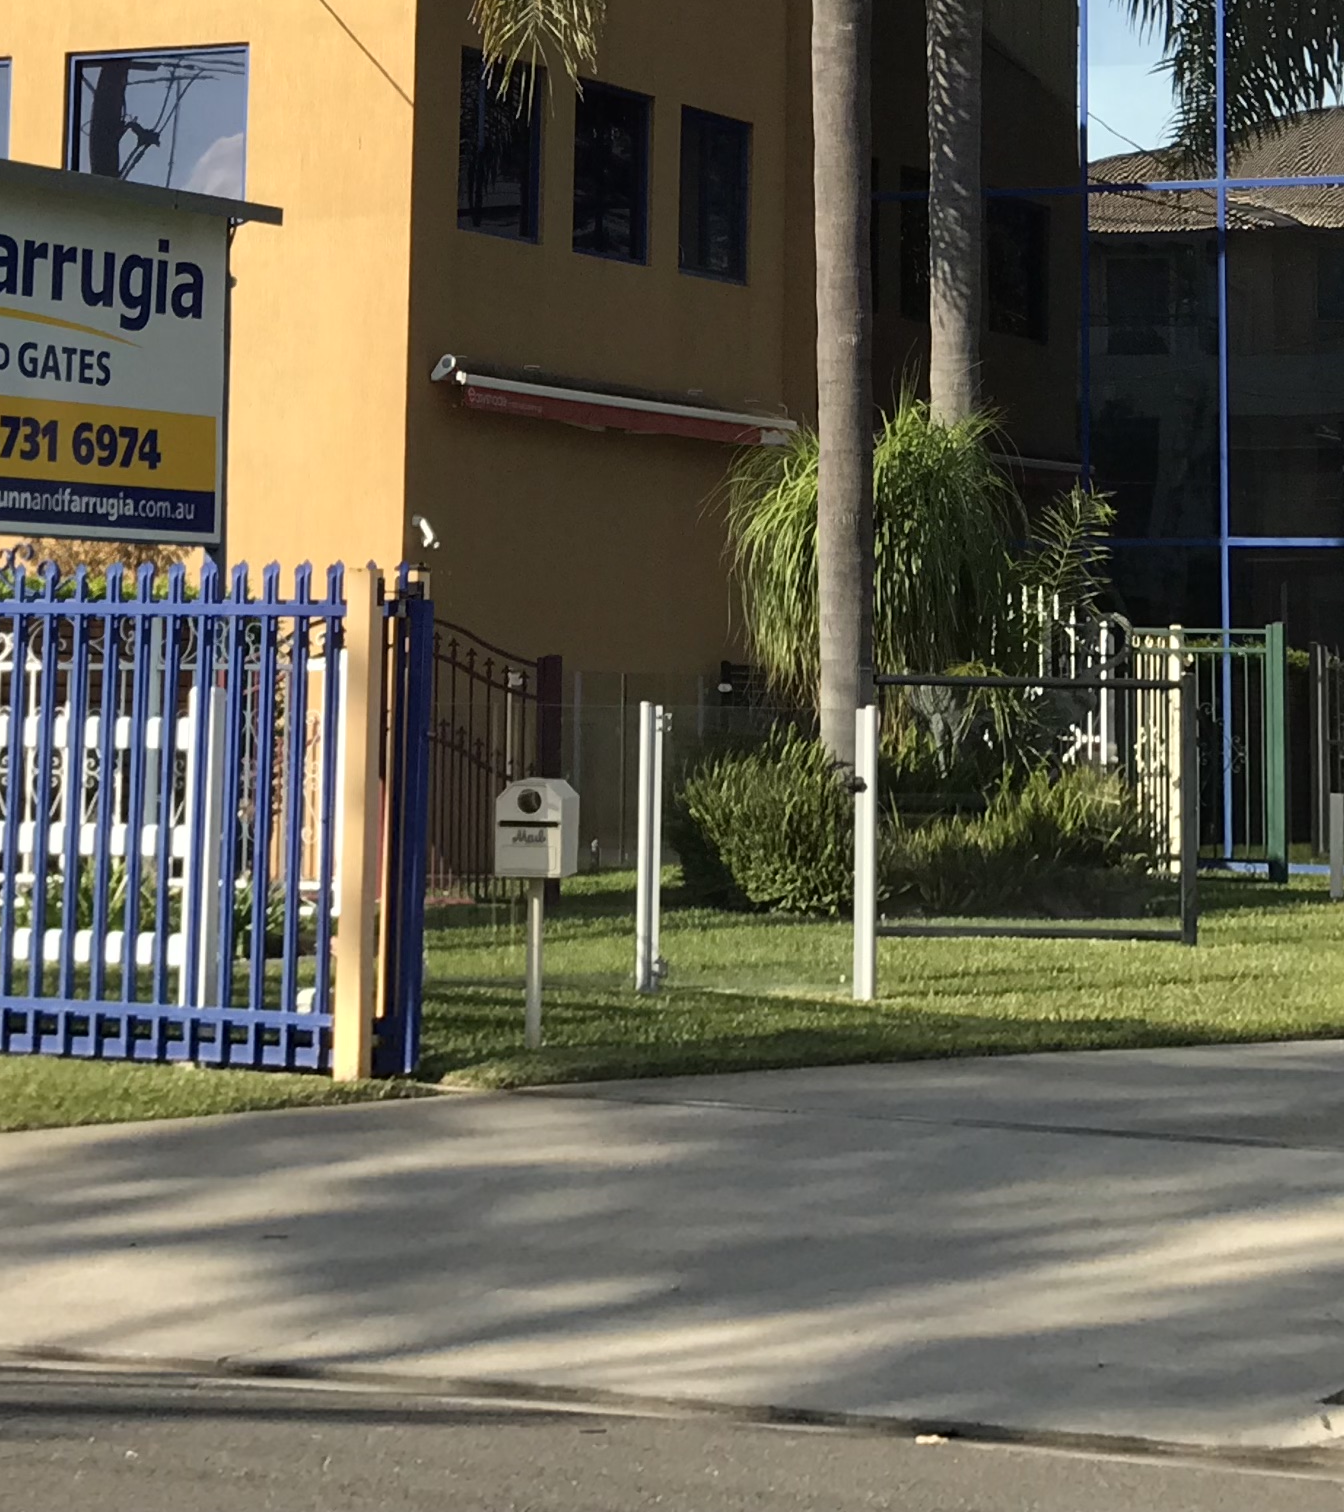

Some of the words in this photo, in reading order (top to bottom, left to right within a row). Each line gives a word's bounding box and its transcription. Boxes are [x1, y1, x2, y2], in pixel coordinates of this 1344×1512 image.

[17, 342, 112, 387] GATES
[71, 421, 162, 470] 6974
[512, 829, 546, 844] Mail
